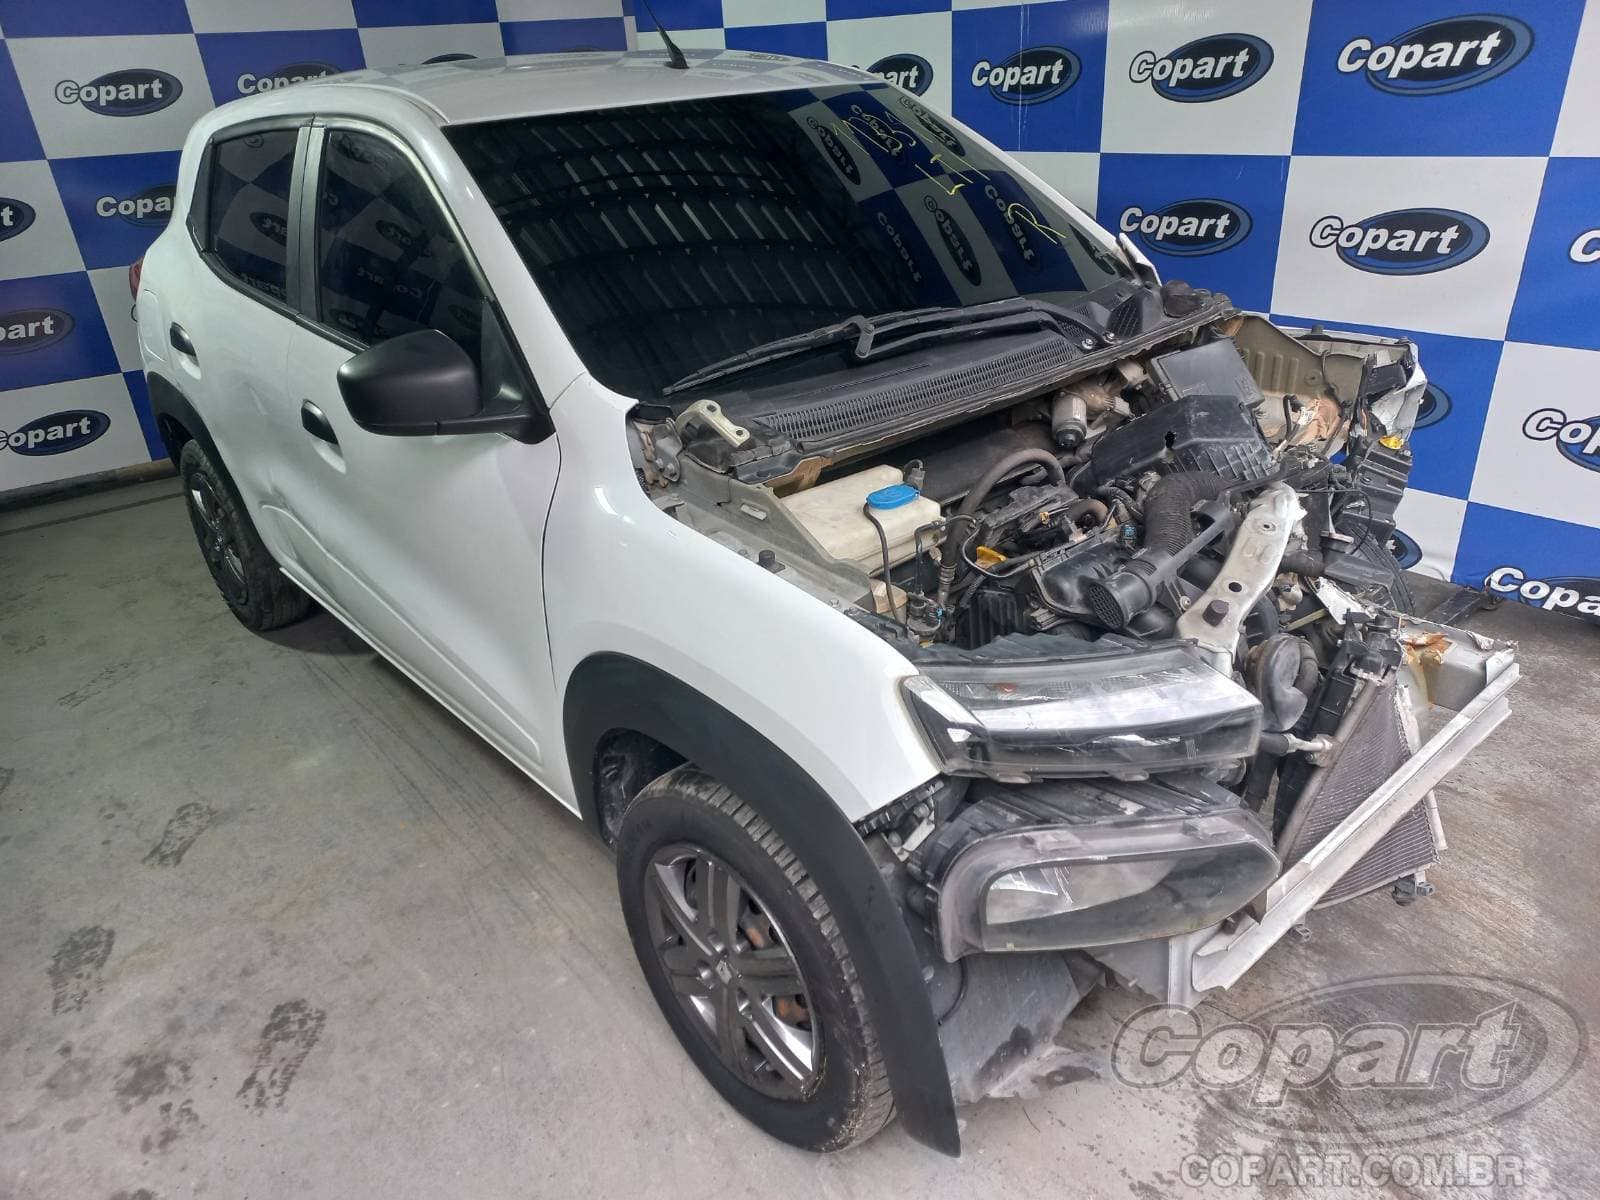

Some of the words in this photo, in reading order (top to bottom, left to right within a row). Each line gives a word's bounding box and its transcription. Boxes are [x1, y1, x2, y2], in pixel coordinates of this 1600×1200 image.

[1130, 48, 1250, 87] Copart
[1338, 30, 1502, 79] Copart
[57, 77, 163, 106] Copart
[971, 59, 1063, 91] Copart
[96, 196, 176, 219] Copa
[1119, 207, 1231, 241] Copart
[1310, 216, 1460, 257] Copart
[0, 315, 54, 343] art
